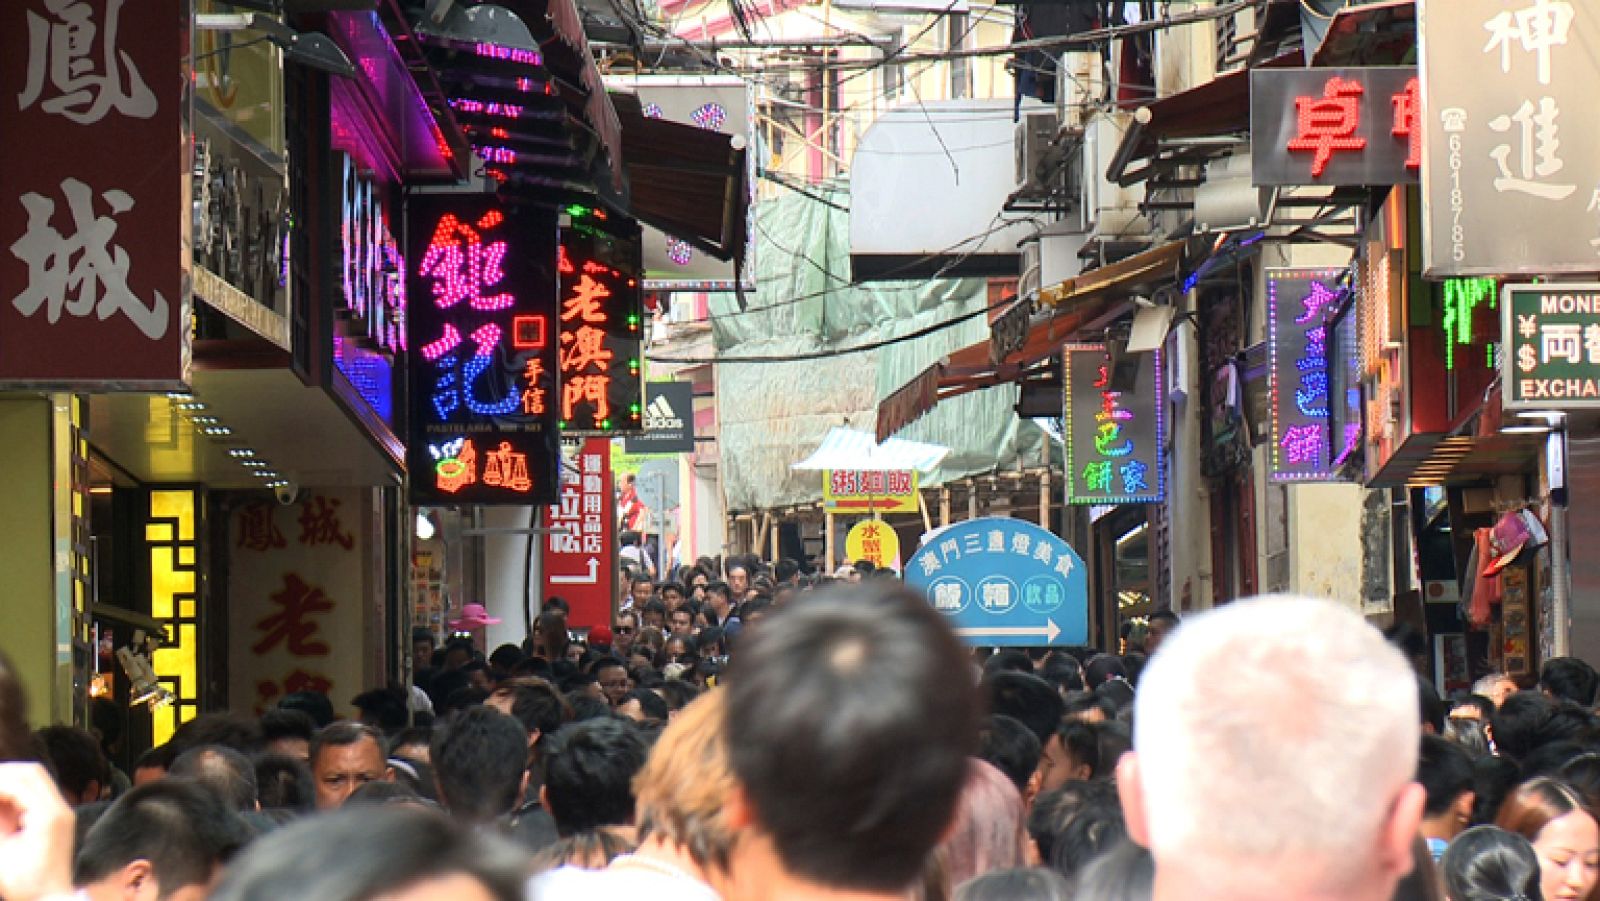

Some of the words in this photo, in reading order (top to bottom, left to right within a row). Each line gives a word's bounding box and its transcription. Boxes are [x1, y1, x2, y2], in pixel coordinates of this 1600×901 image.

[1482, 0, 1577, 200] 神進
[10, 0, 170, 341] 鳳城
[560, 275, 614, 421] 老澳門
[1518, 343, 1536, 372] $
[522, 358, 545, 415] 手信
[1093, 353, 1135, 456] 三巴
[1521, 378, 1600, 397] EXCHA
[1082, 460, 1150, 494] 餅家
[236, 496, 355, 551] 鳳城
